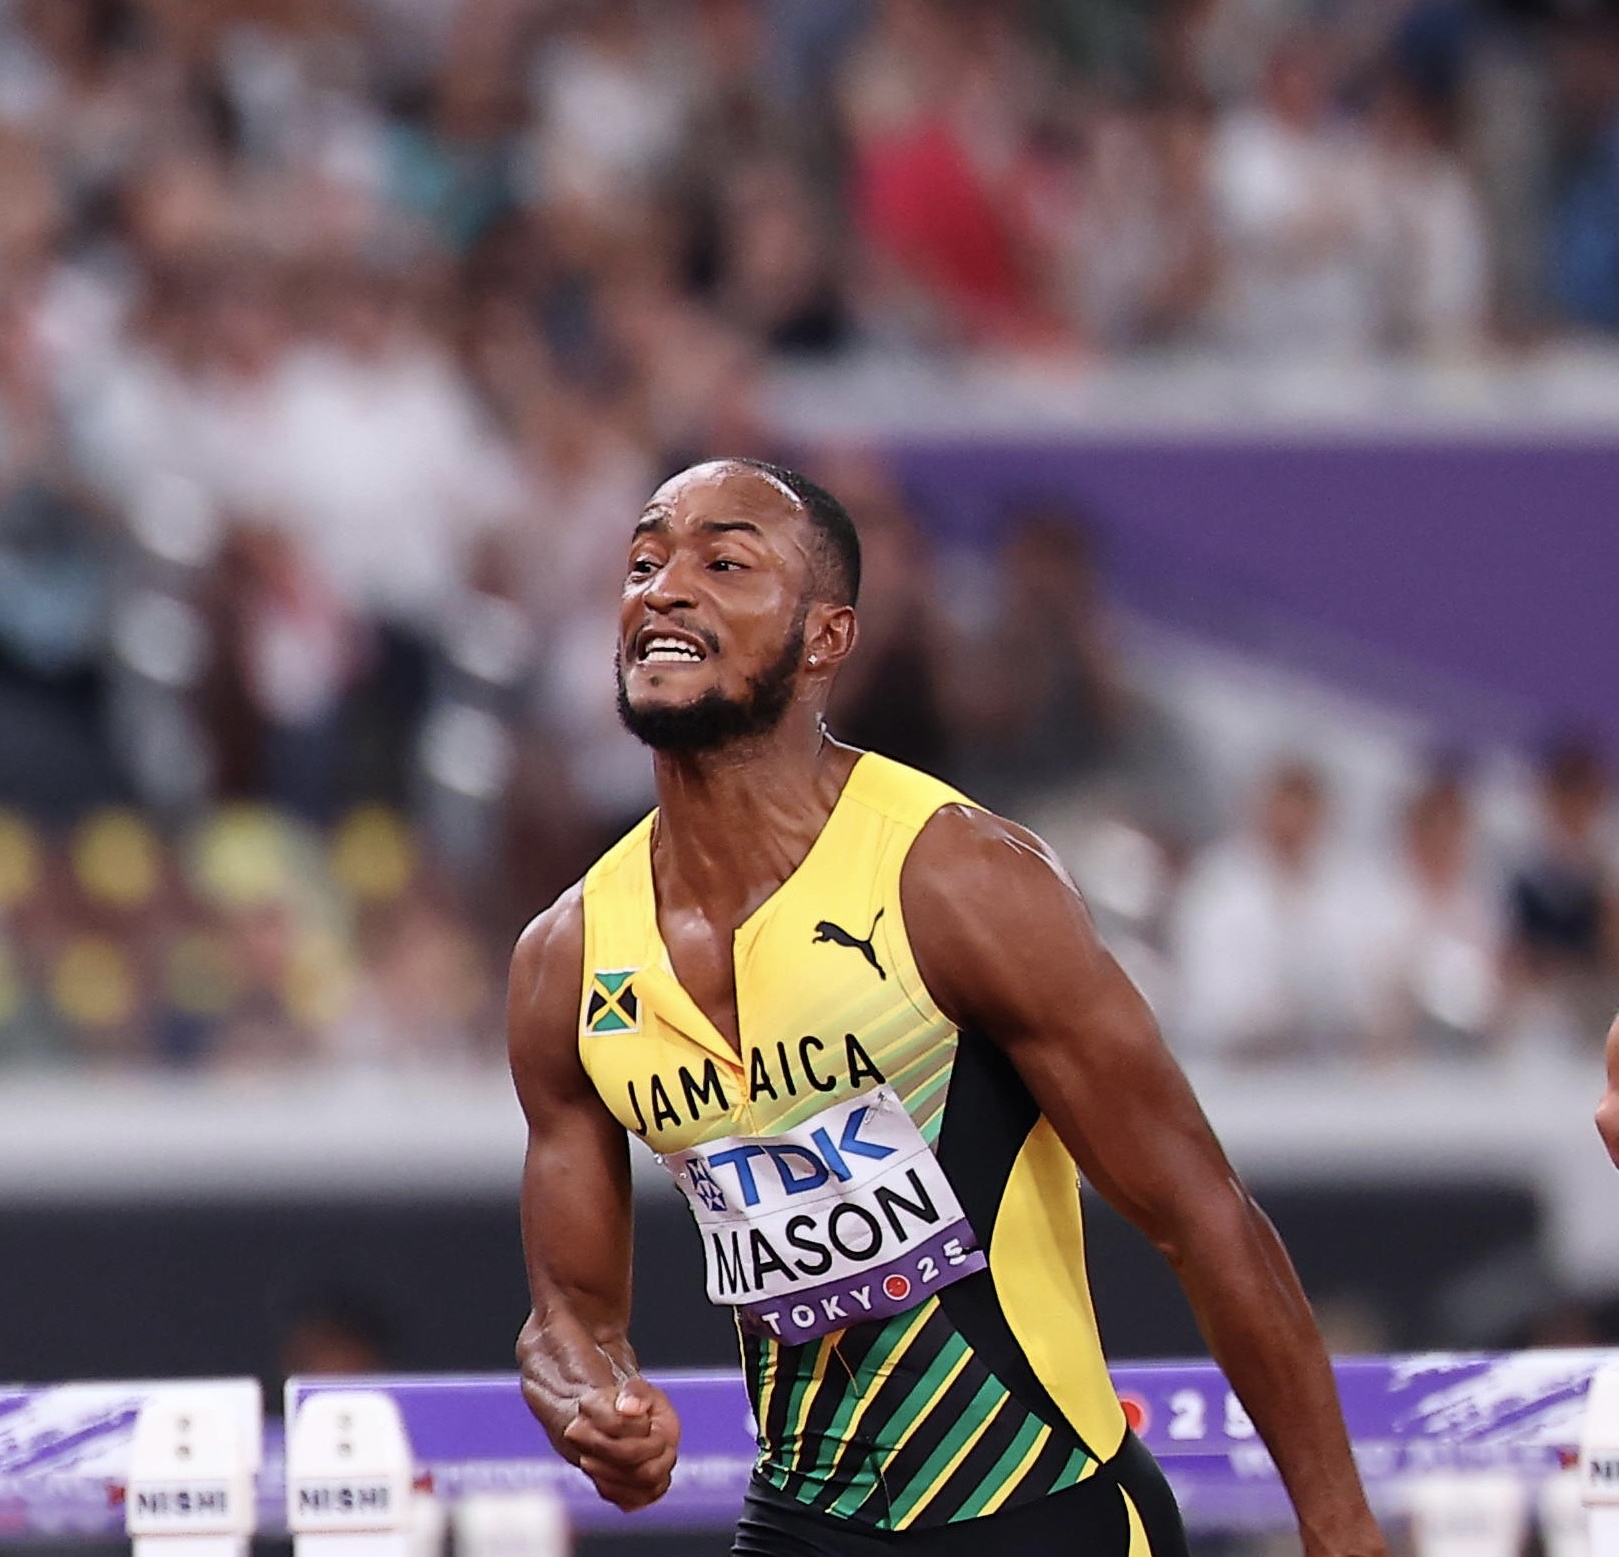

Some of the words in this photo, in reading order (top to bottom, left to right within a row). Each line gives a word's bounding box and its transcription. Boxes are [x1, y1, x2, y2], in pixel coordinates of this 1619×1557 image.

[627, 1033, 887, 1135] JAMAICA
[709, 1105, 898, 1207] TDK
[713, 1168, 940, 1295] MASON
[138, 1490, 225, 1517] NISHI
[299, 1487, 389, 1513] NISHI
